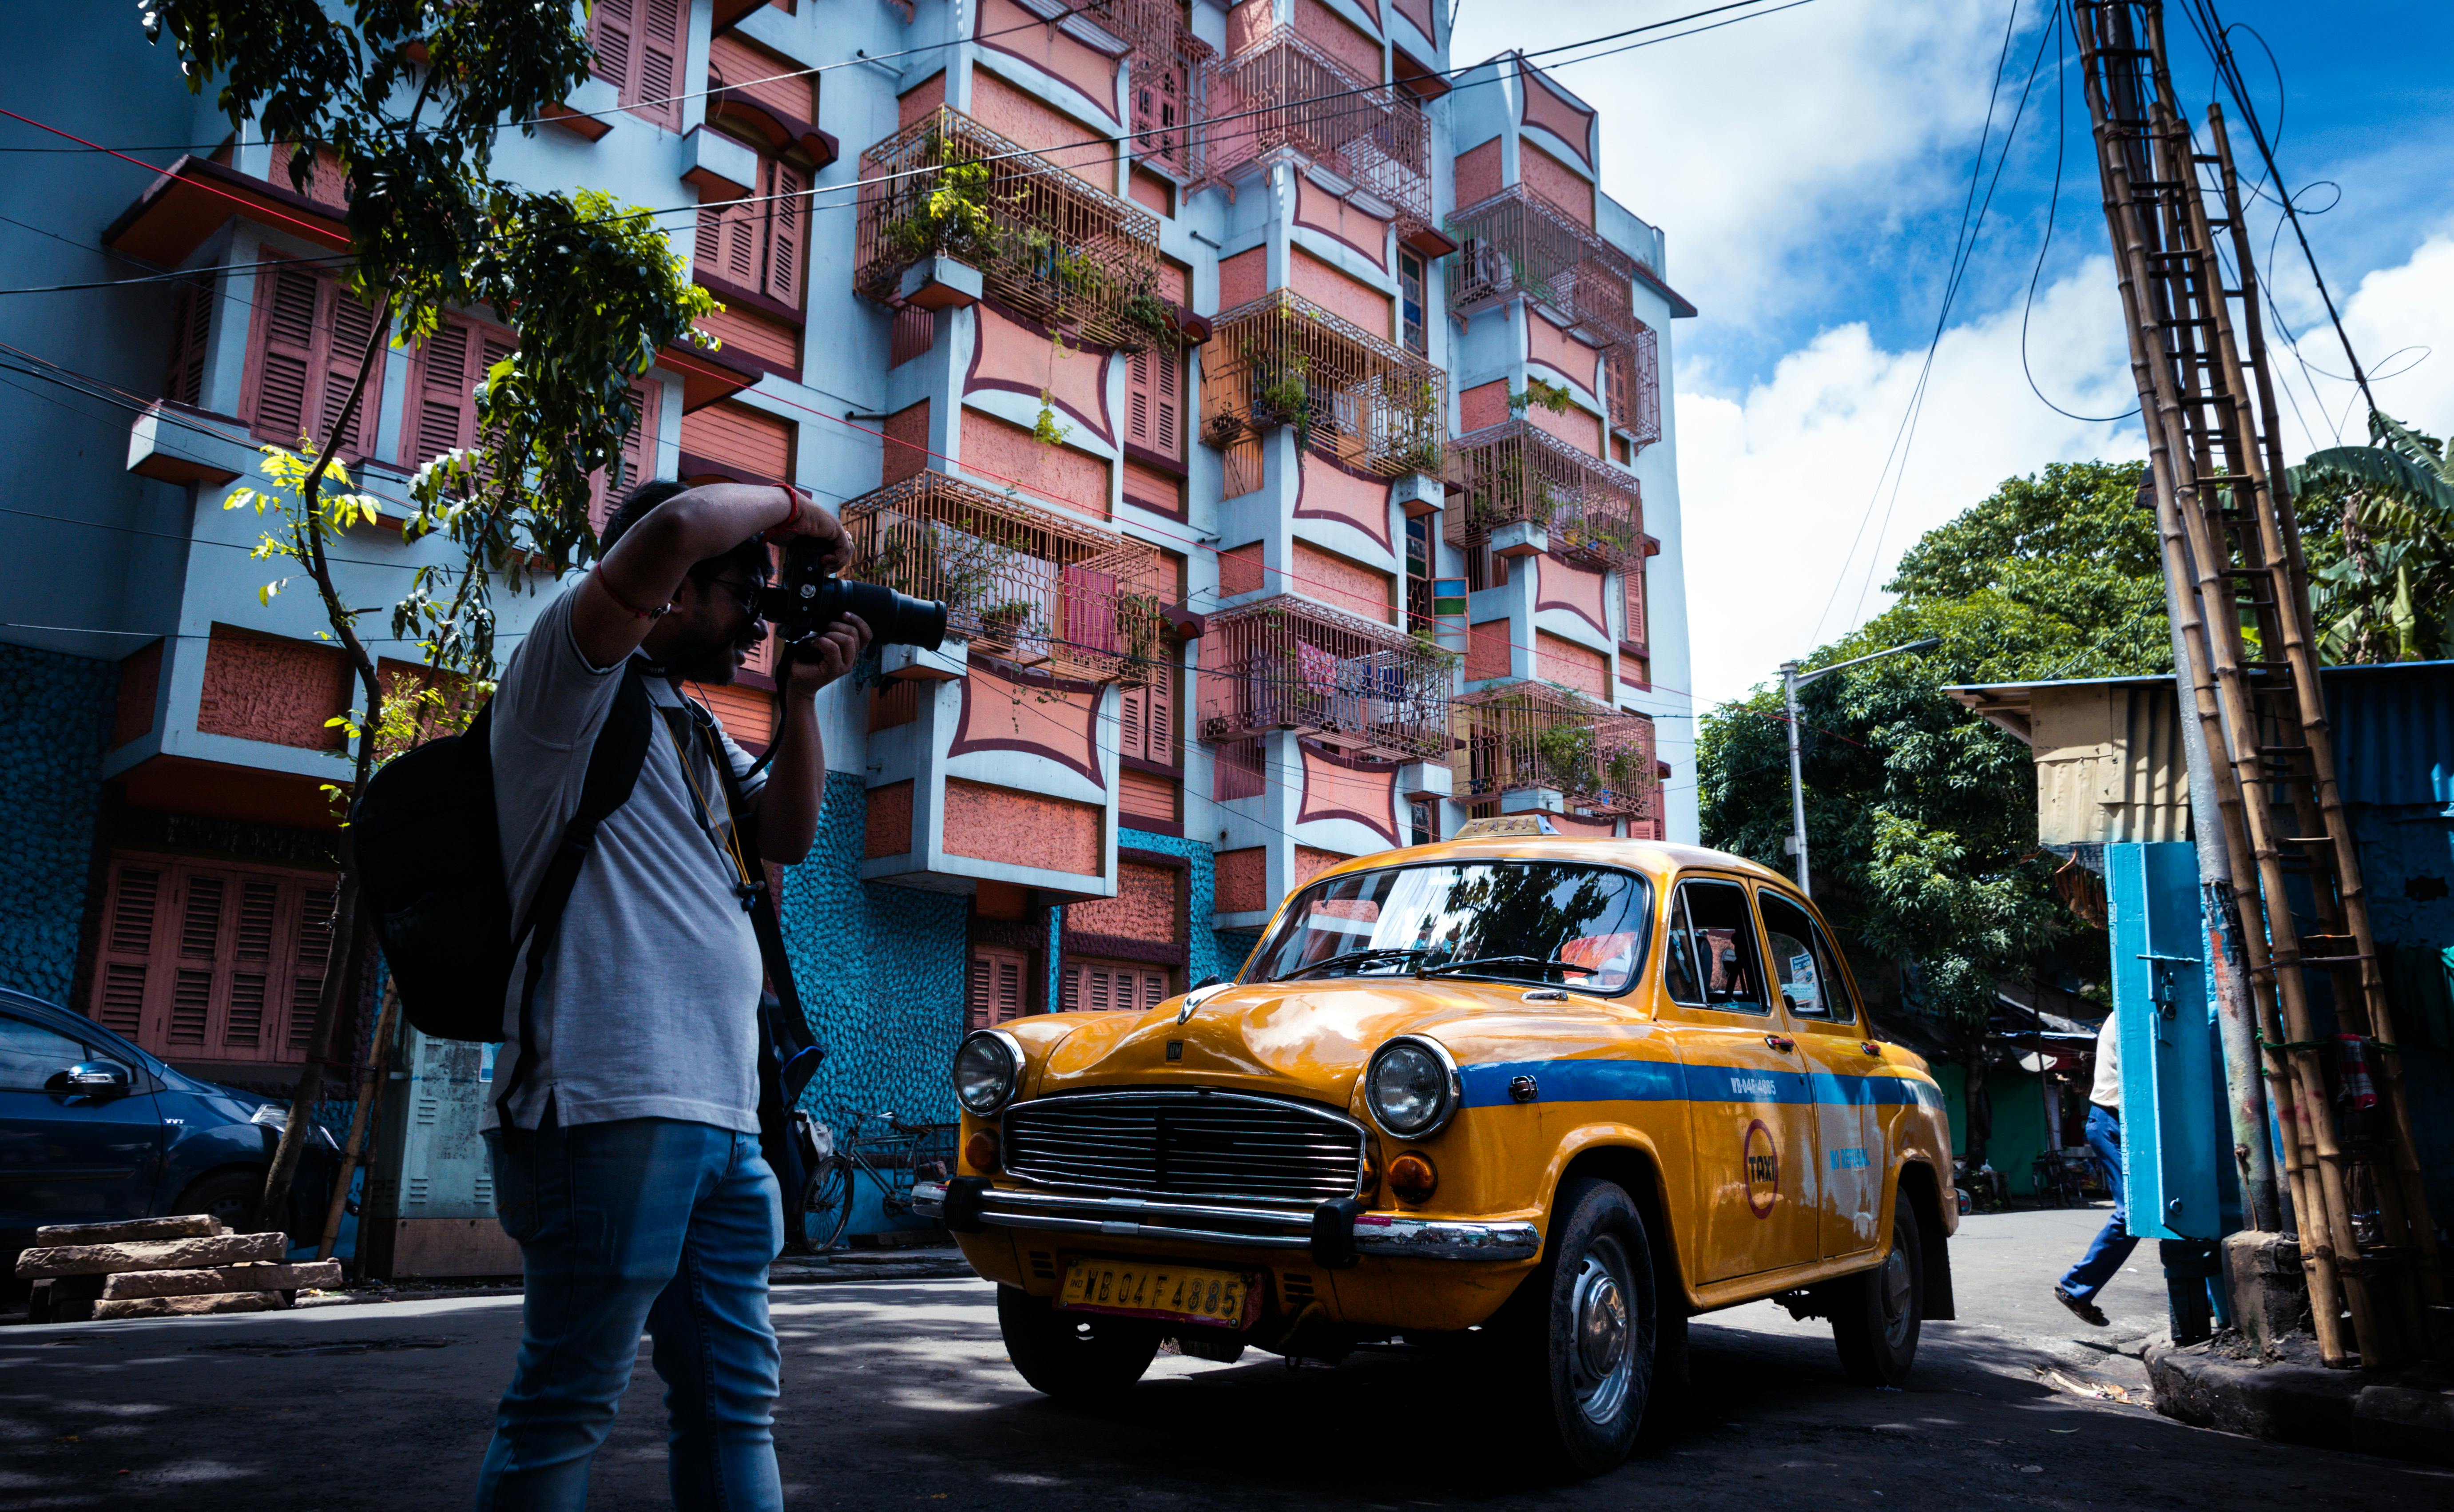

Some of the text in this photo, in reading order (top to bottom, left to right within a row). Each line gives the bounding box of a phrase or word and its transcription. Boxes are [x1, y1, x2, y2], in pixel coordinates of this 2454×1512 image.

[1473, 818, 1529, 832] TAXI
[1748, 1155, 1775, 1183] TAXI
[1070, 1279, 1083, 1288] IND
